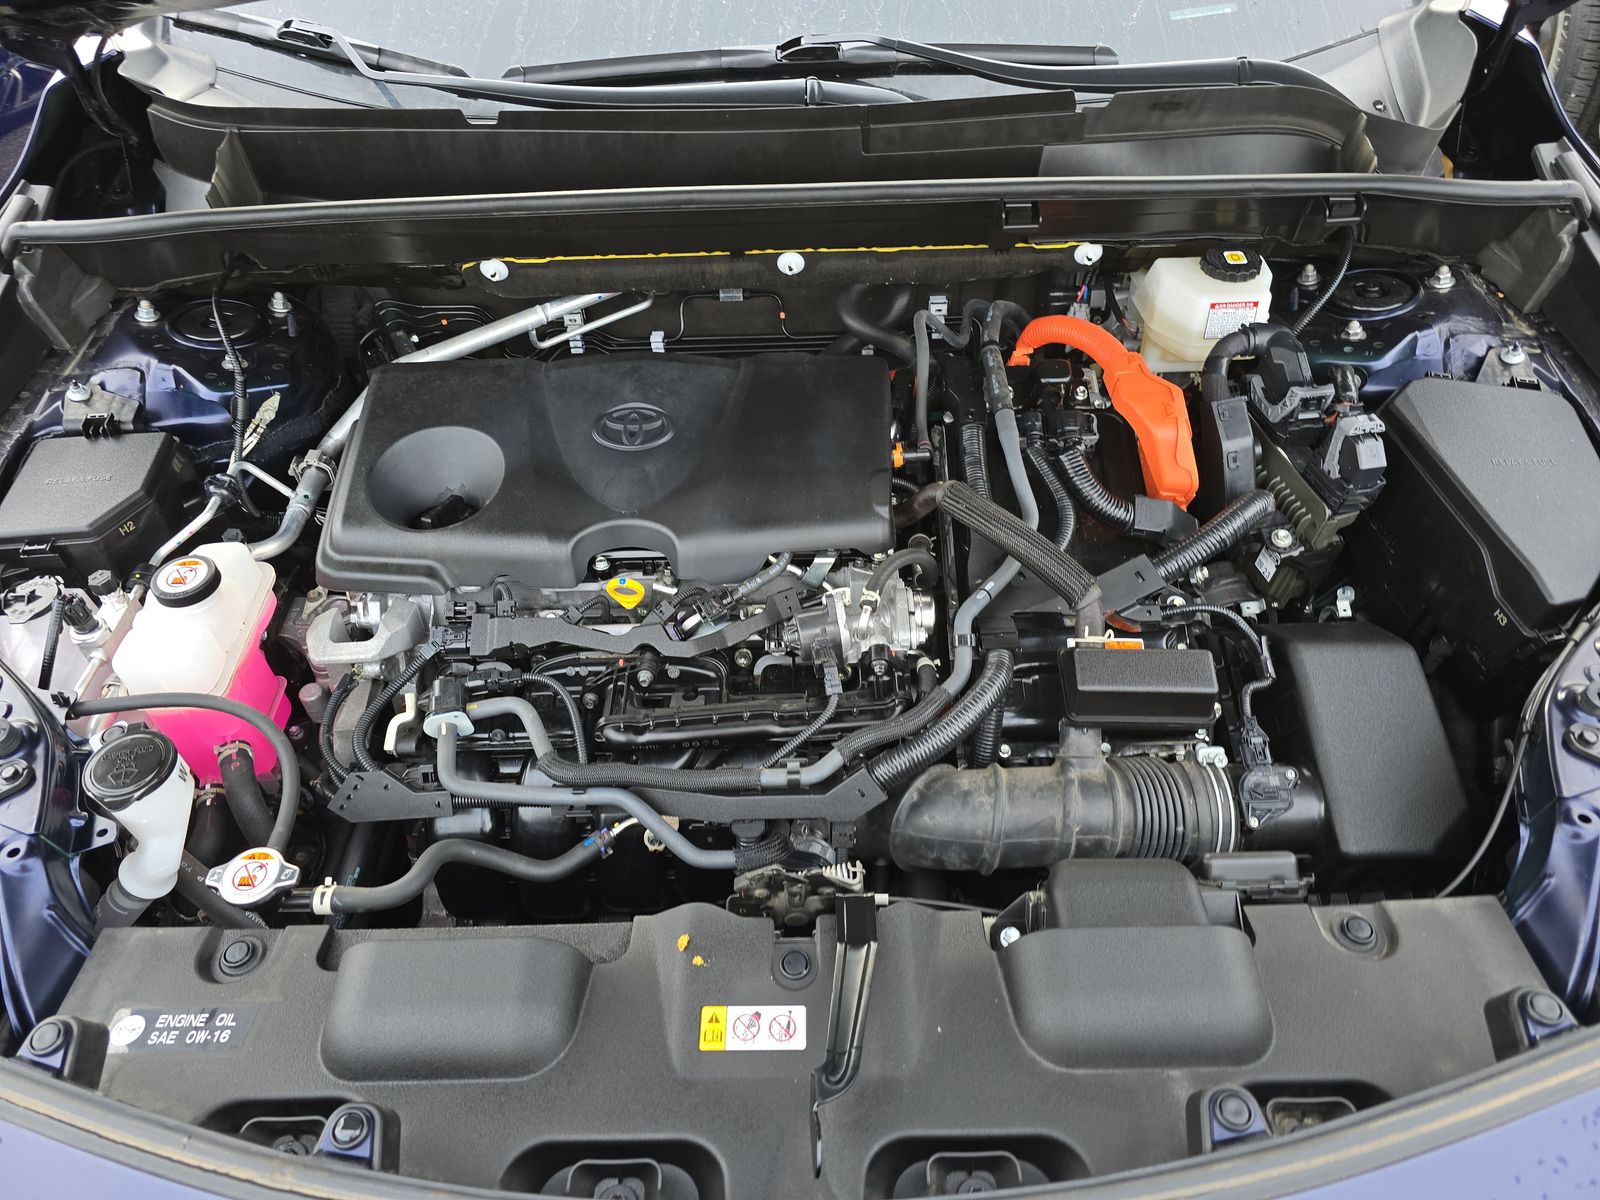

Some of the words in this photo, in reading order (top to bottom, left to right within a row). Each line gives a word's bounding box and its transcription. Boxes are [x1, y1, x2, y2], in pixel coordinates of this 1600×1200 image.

[87, 474, 113, 483] FUSE
[118, 520, 137, 537] H2
[1493, 608, 1508, 627] H3
[230, 761, 240, 771] P
[155, 1013, 209, 1028] ENGINE
[215, 1013, 237, 1027] OIL
[147, 1031, 179, 1045] SAE
